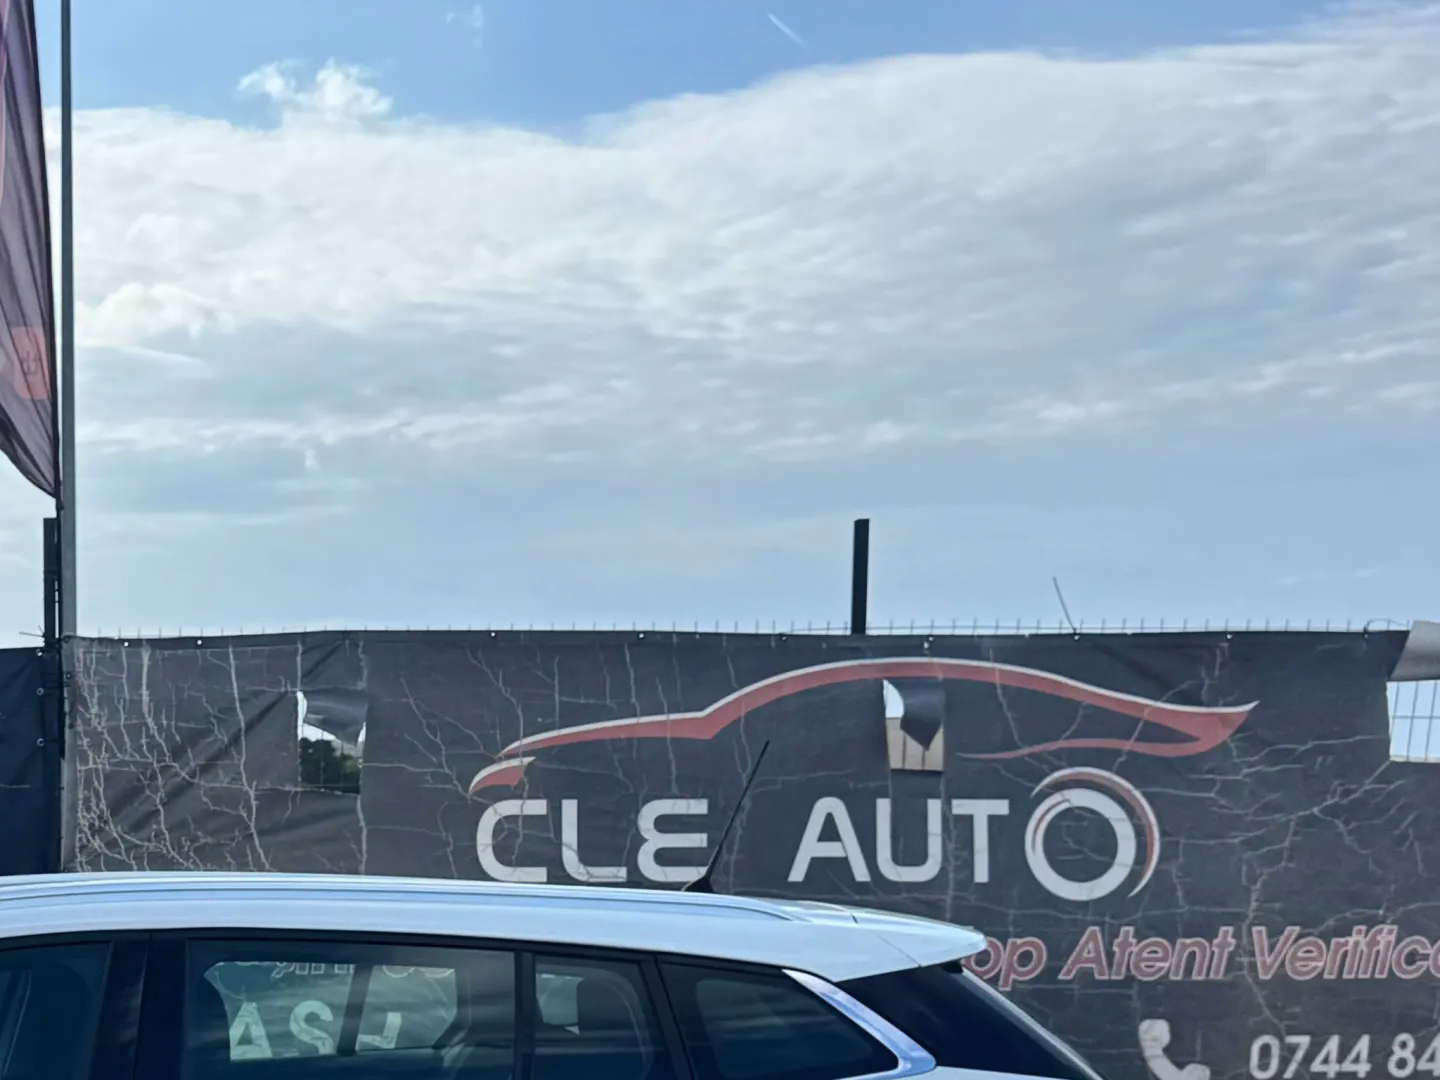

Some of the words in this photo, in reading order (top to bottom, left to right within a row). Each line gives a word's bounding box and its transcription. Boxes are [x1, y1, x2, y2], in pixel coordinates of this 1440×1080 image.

[476, 799, 709, 883] CLE
[787, 787, 1137, 901] AUTO
[960, 935, 1048, 991] op
[1057, 925, 1236, 981] Atent
[1252, 925, 1440, 981] Verific
[1249, 1033, 1372, 1079] 0744
